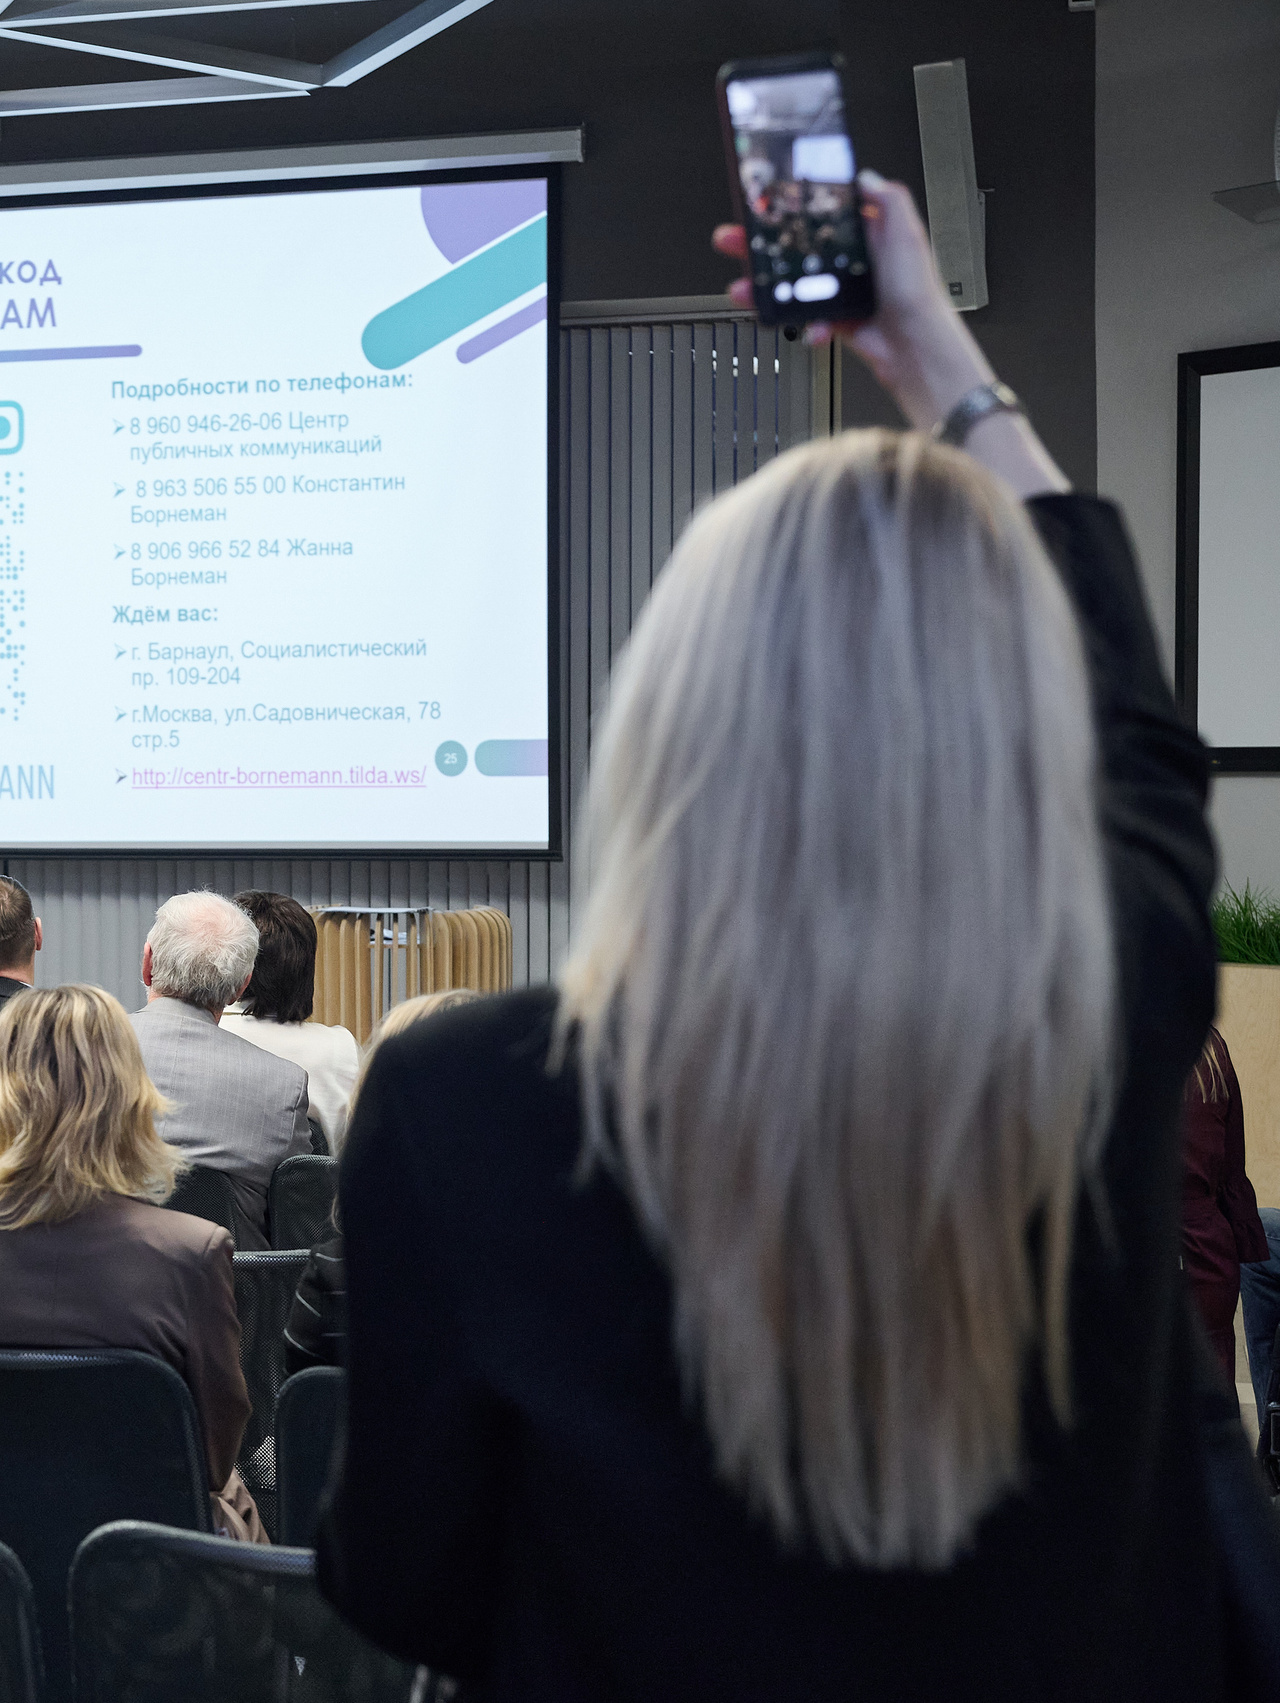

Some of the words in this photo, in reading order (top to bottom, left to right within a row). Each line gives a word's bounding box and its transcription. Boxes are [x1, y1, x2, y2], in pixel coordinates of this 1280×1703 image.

[111, 378, 249, 402] Подробности
[255, 379, 281, 394] по
[287, 372, 414, 395] телефонам:
[129, 417, 142, 436] 8
[146, 415, 182, 435] 960
[186, 411, 283, 434] 946-26-06
[288, 411, 350, 434] Центр
[130, 441, 235, 465] публичных
[239, 435, 383, 460] коммуникаций
[135, 480, 148, 499] 8
[152, 479, 188, 498] 963
[192, 477, 228, 497] 506
[233, 476, 258, 496] 55
[262, 475, 287, 495] 00
[292, 474, 407, 494] Константин
[130, 504, 227, 527] Борнеман
[130, 542, 143, 561] 8
[147, 541, 183, 561] 906
[187, 540, 223, 560] 966
[228, 538, 252, 559] 52
[257, 538, 281, 558] 84
[286, 538, 354, 558] Жанна
[131, 567, 228, 590] Борнеман
[111, 605, 171, 626] Ждём
[177, 607, 219, 623] вас:
[131, 646, 141, 661] г.
[147, 641, 234, 664] Барнаул,
[240, 637, 427, 661] Социалистический
[131, 671, 159, 690] пр.
[166, 666, 242, 687] 109-204
[131, 704, 218, 726] г.Москва,
[224, 702, 411, 727] ул.Садовническая,
[418, 700, 442, 720] 78
[131, 729, 181, 752] стр.5
[444, 753, 458, 765] 25
[131, 765, 427, 788] http://centr-bornemann.tilda.ws/
